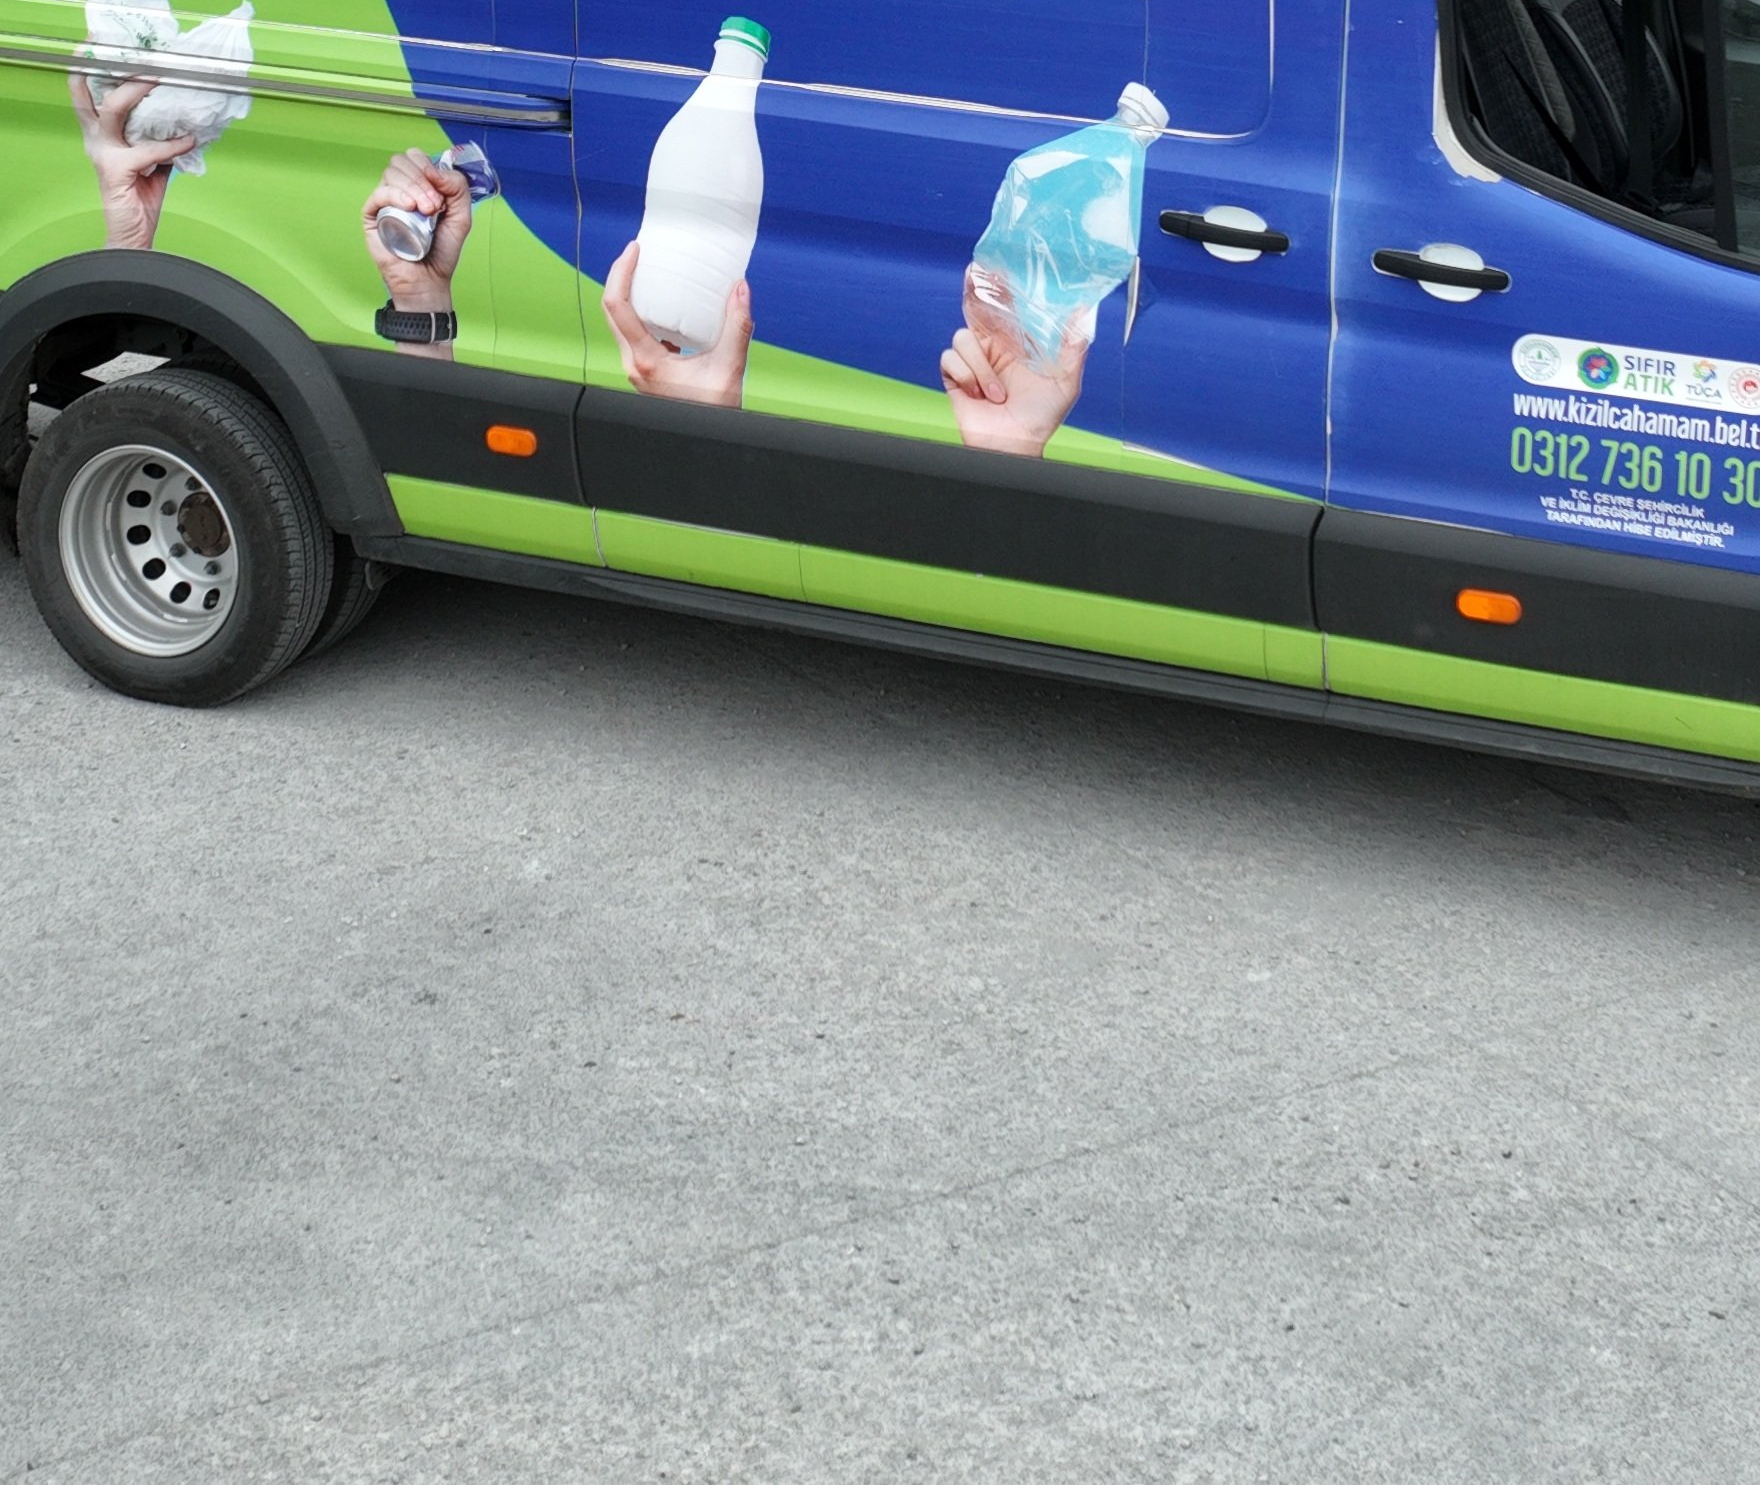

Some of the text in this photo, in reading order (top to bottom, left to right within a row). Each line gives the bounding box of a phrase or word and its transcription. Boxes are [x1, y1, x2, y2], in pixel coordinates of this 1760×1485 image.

[1624, 355, 1675, 376] SIFIR
[1623, 373, 1674, 396] ATIK
[1511, 426, 1589, 481] 0312
[1600, 439, 1663, 492] 736
[1674, 450, 1711, 499] 10
